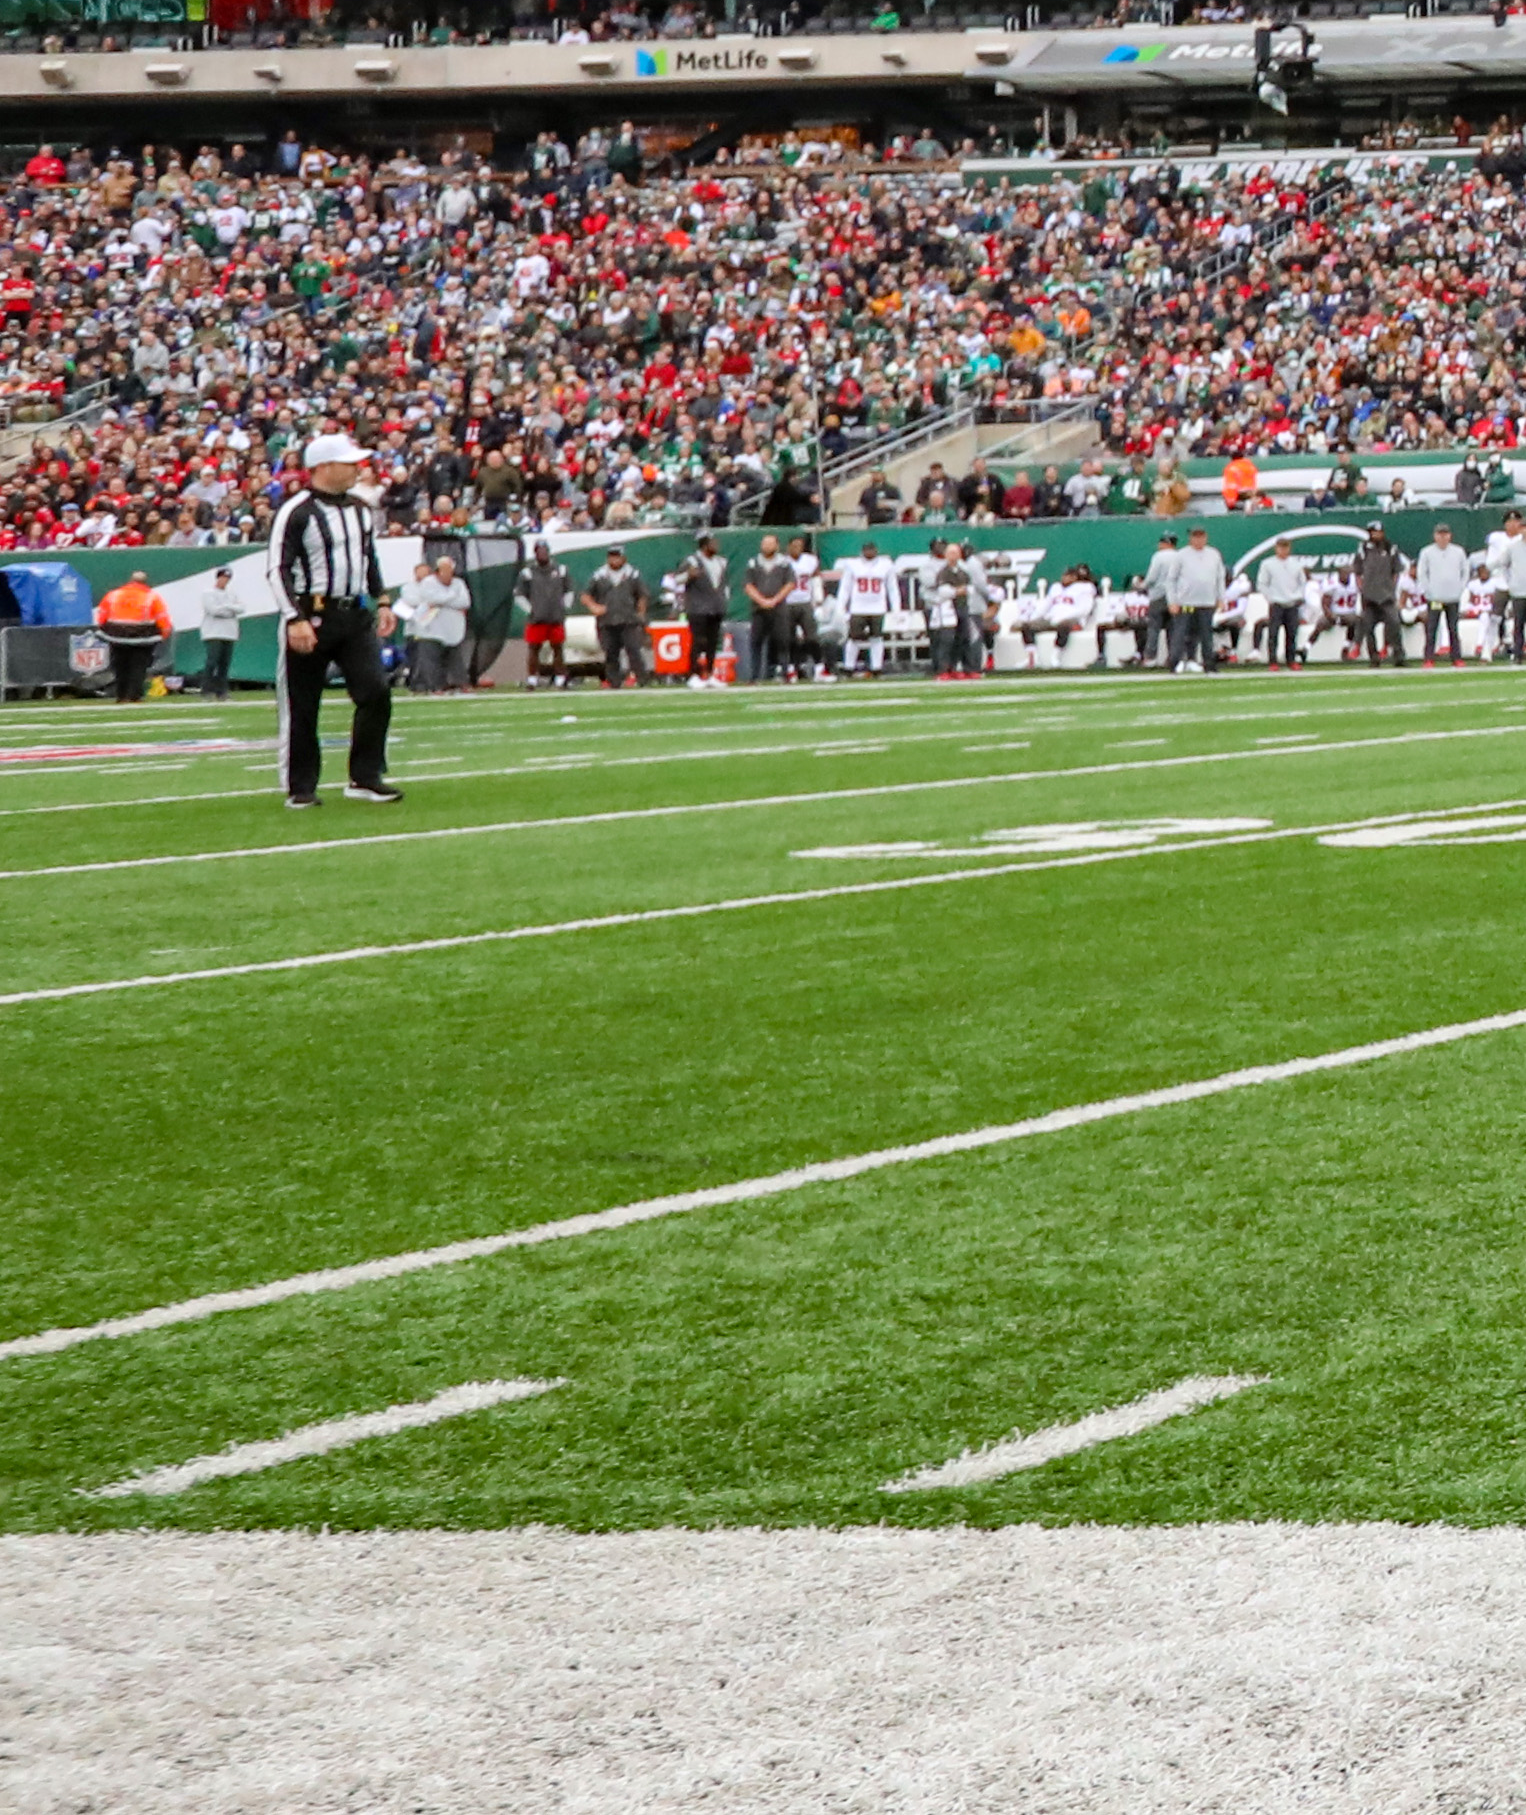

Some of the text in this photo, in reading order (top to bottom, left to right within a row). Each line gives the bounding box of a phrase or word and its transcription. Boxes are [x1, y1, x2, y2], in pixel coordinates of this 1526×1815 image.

[675, 49, 769, 71] MetLife
[74, 649, 103, 668] NFL
[657, 634, 682, 662] G
